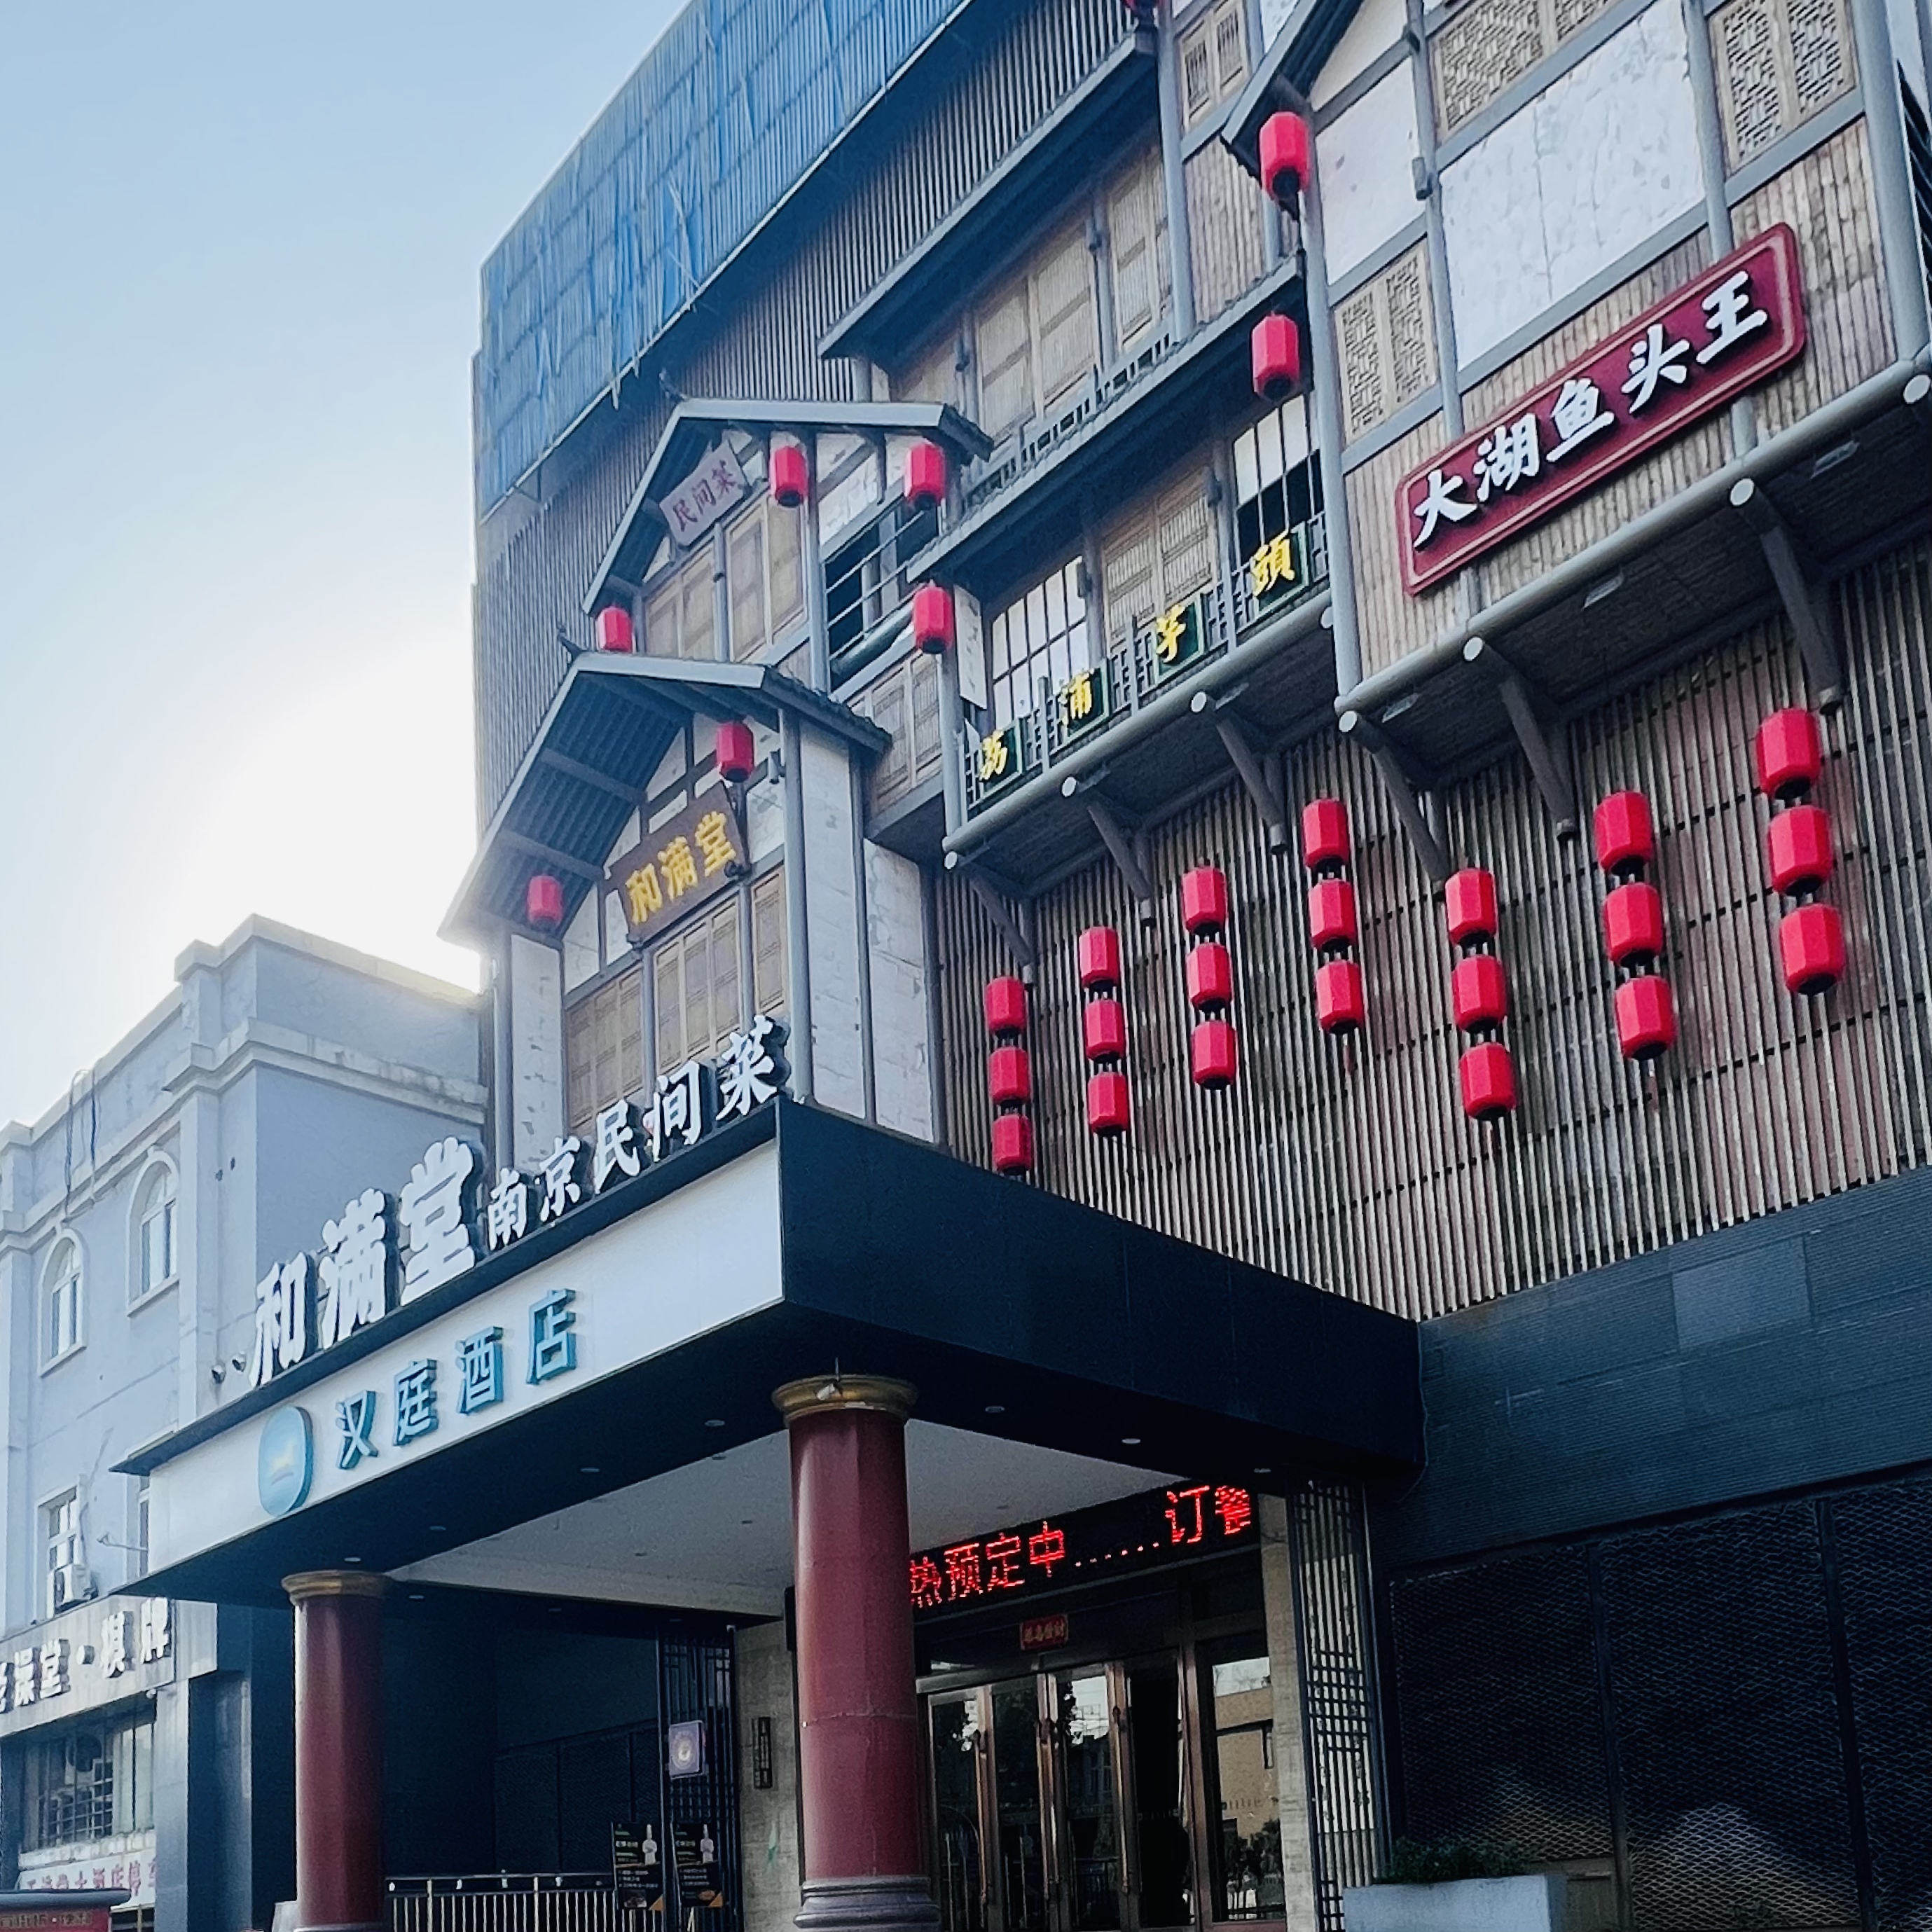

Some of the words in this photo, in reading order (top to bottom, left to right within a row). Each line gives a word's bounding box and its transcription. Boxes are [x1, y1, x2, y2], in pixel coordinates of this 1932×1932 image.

[672, 459, 737, 532] 民间菜
[1413, 270, 1768, 548] 大湖鱼头王
[625, 810, 736, 926] 和满堂
[248, 1136, 476, 1388] 和满堂
[488, 1015, 778, 1250] 南京民间菜
[337, 1288, 579, 1470] 汉庭酒店
